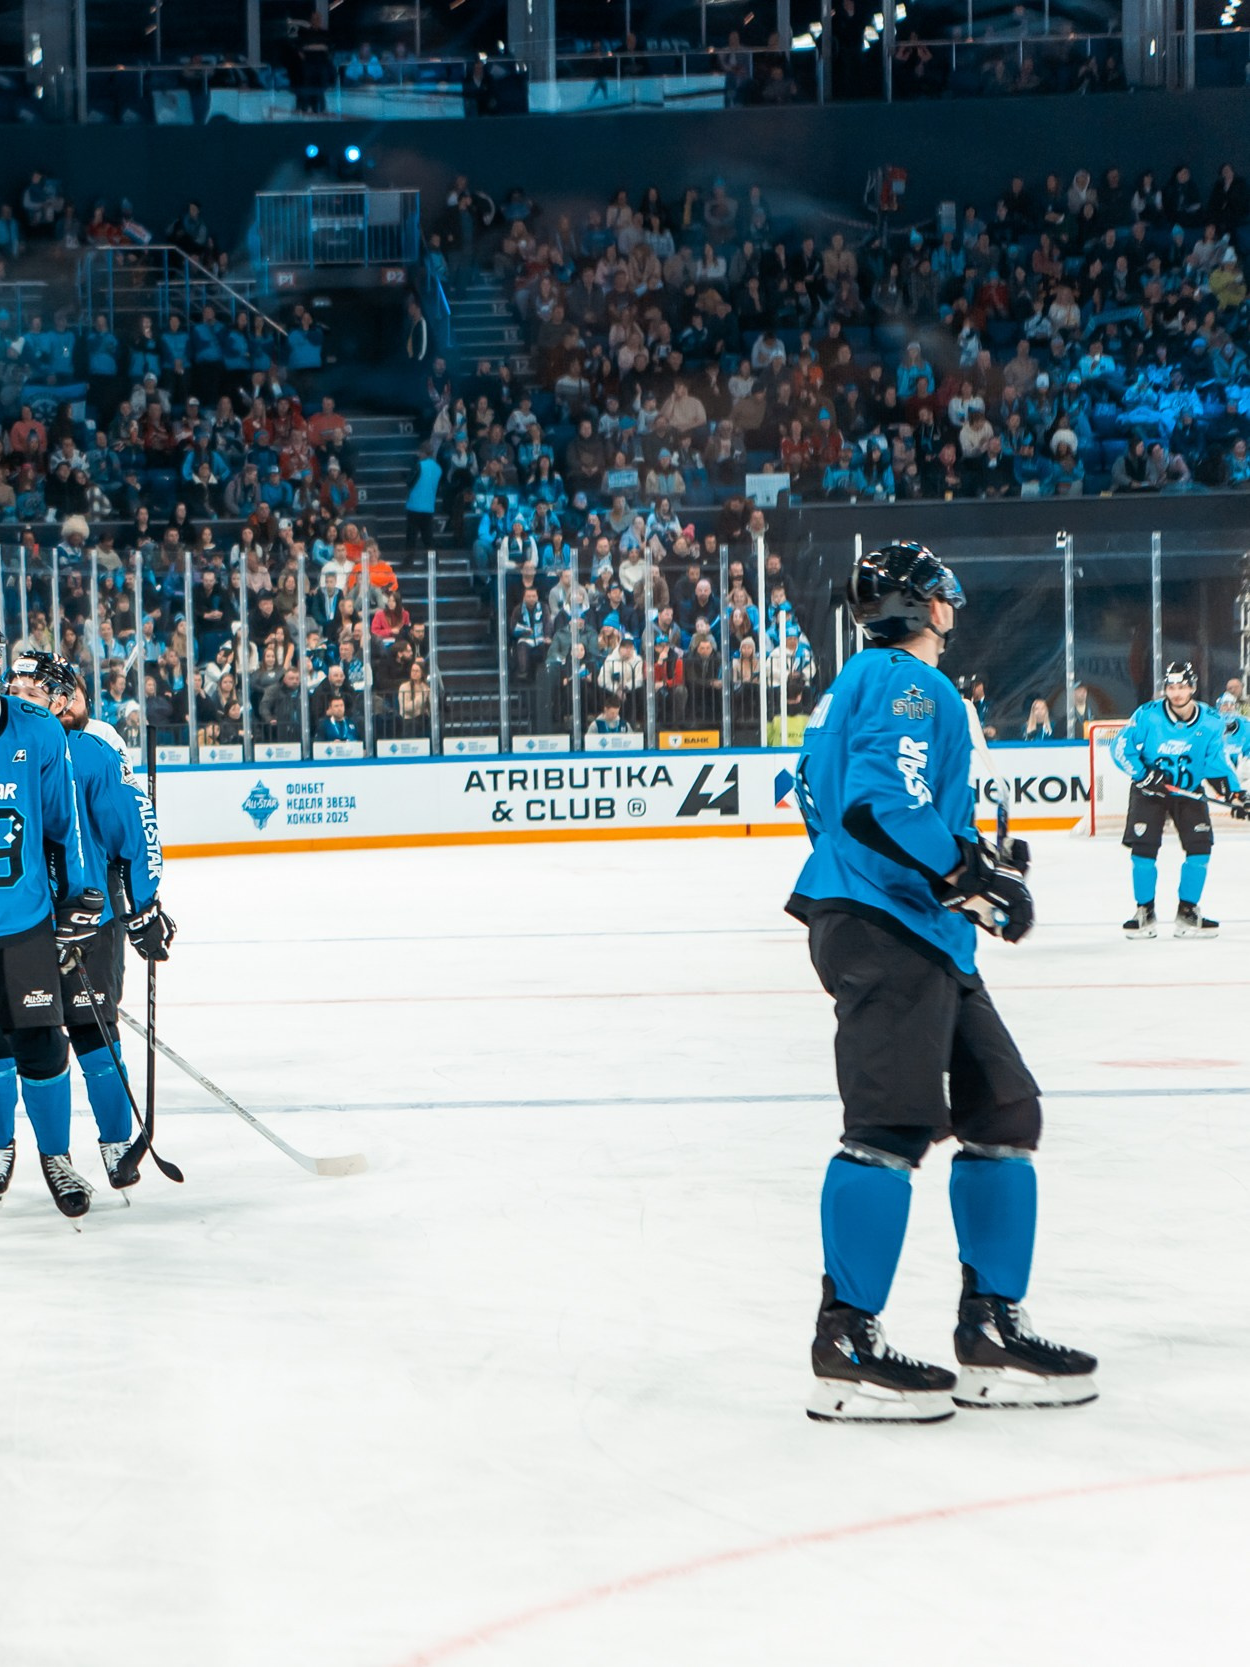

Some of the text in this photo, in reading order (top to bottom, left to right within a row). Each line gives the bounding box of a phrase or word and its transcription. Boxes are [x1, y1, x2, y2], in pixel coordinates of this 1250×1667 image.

[464, 764, 674, 793] ATRIBUTIKA
[286, 782, 324, 794] ФОНБЕТ
[286, 796, 356, 811] НЕДЕЛЯ ЗВЕЗД
[491, 801, 514, 822] &
[526, 798, 616, 821] CLUB
[286, 812, 349, 825] ХОККЕЯ 2025
